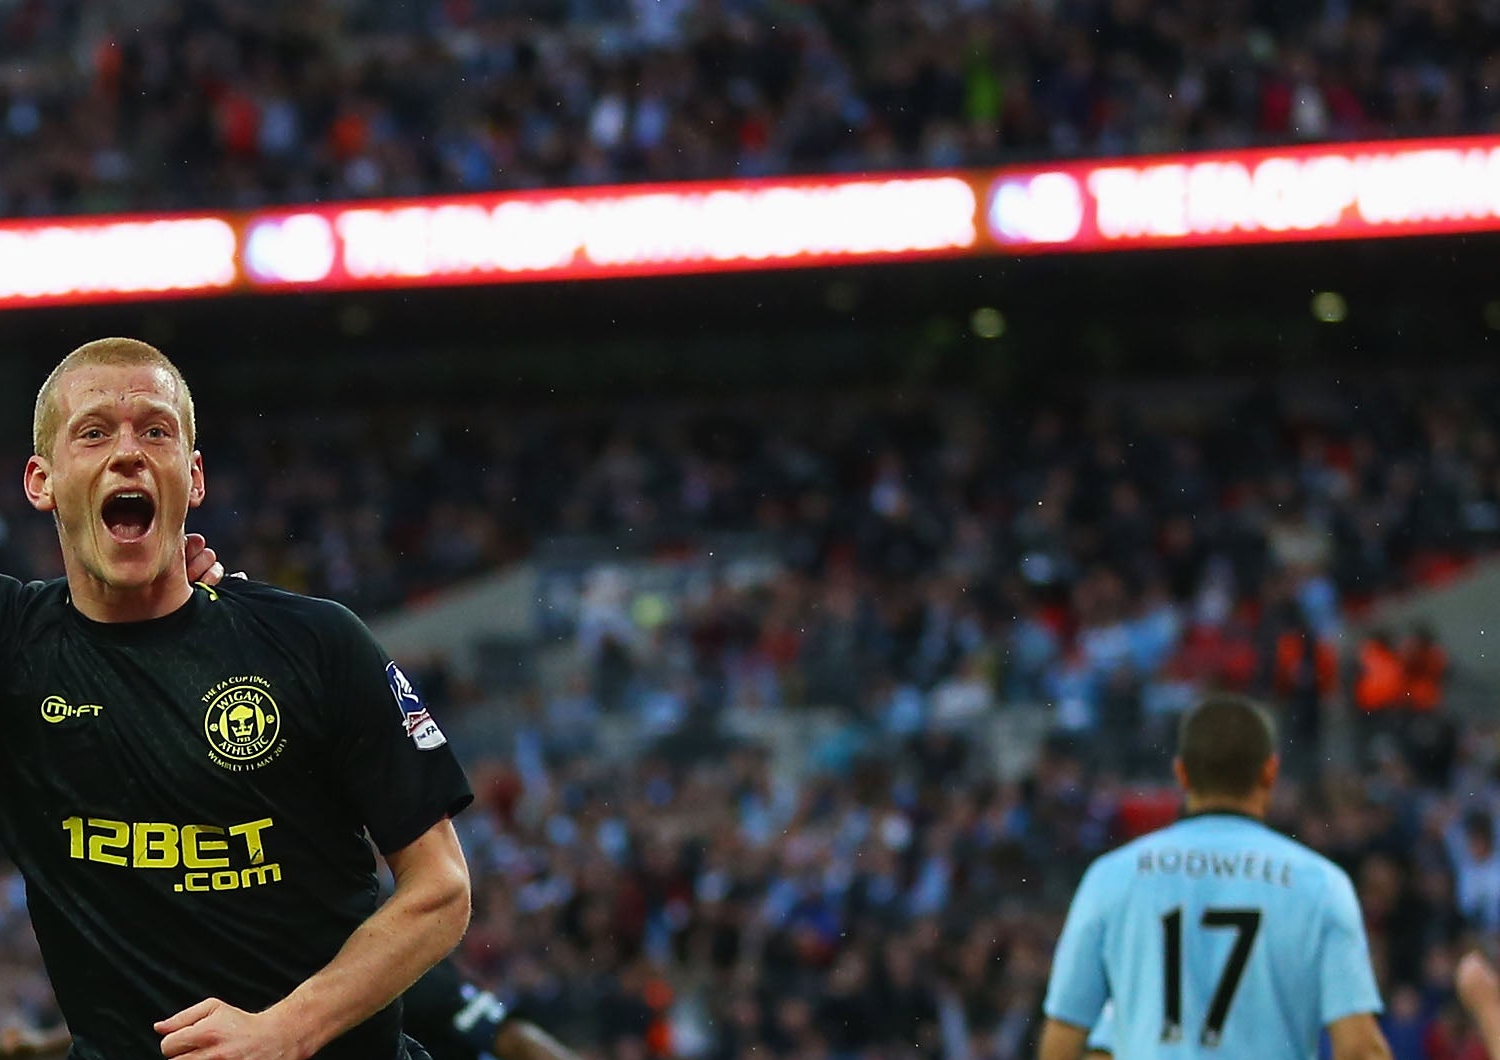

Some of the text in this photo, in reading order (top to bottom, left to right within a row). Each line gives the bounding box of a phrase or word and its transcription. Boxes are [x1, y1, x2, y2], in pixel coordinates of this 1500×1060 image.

[216, 690, 263, 710] WIGAN
[218, 735, 269, 756] ATHLETIC
[207, 750, 243, 772] WEMBLEY
[256, 754, 274, 769] MAY
[62, 816, 273, 868] 12BET
[174, 863, 282, 892] .com
[1137, 850, 1292, 888] RODWELL
[1159, 903, 1263, 1047] 17
